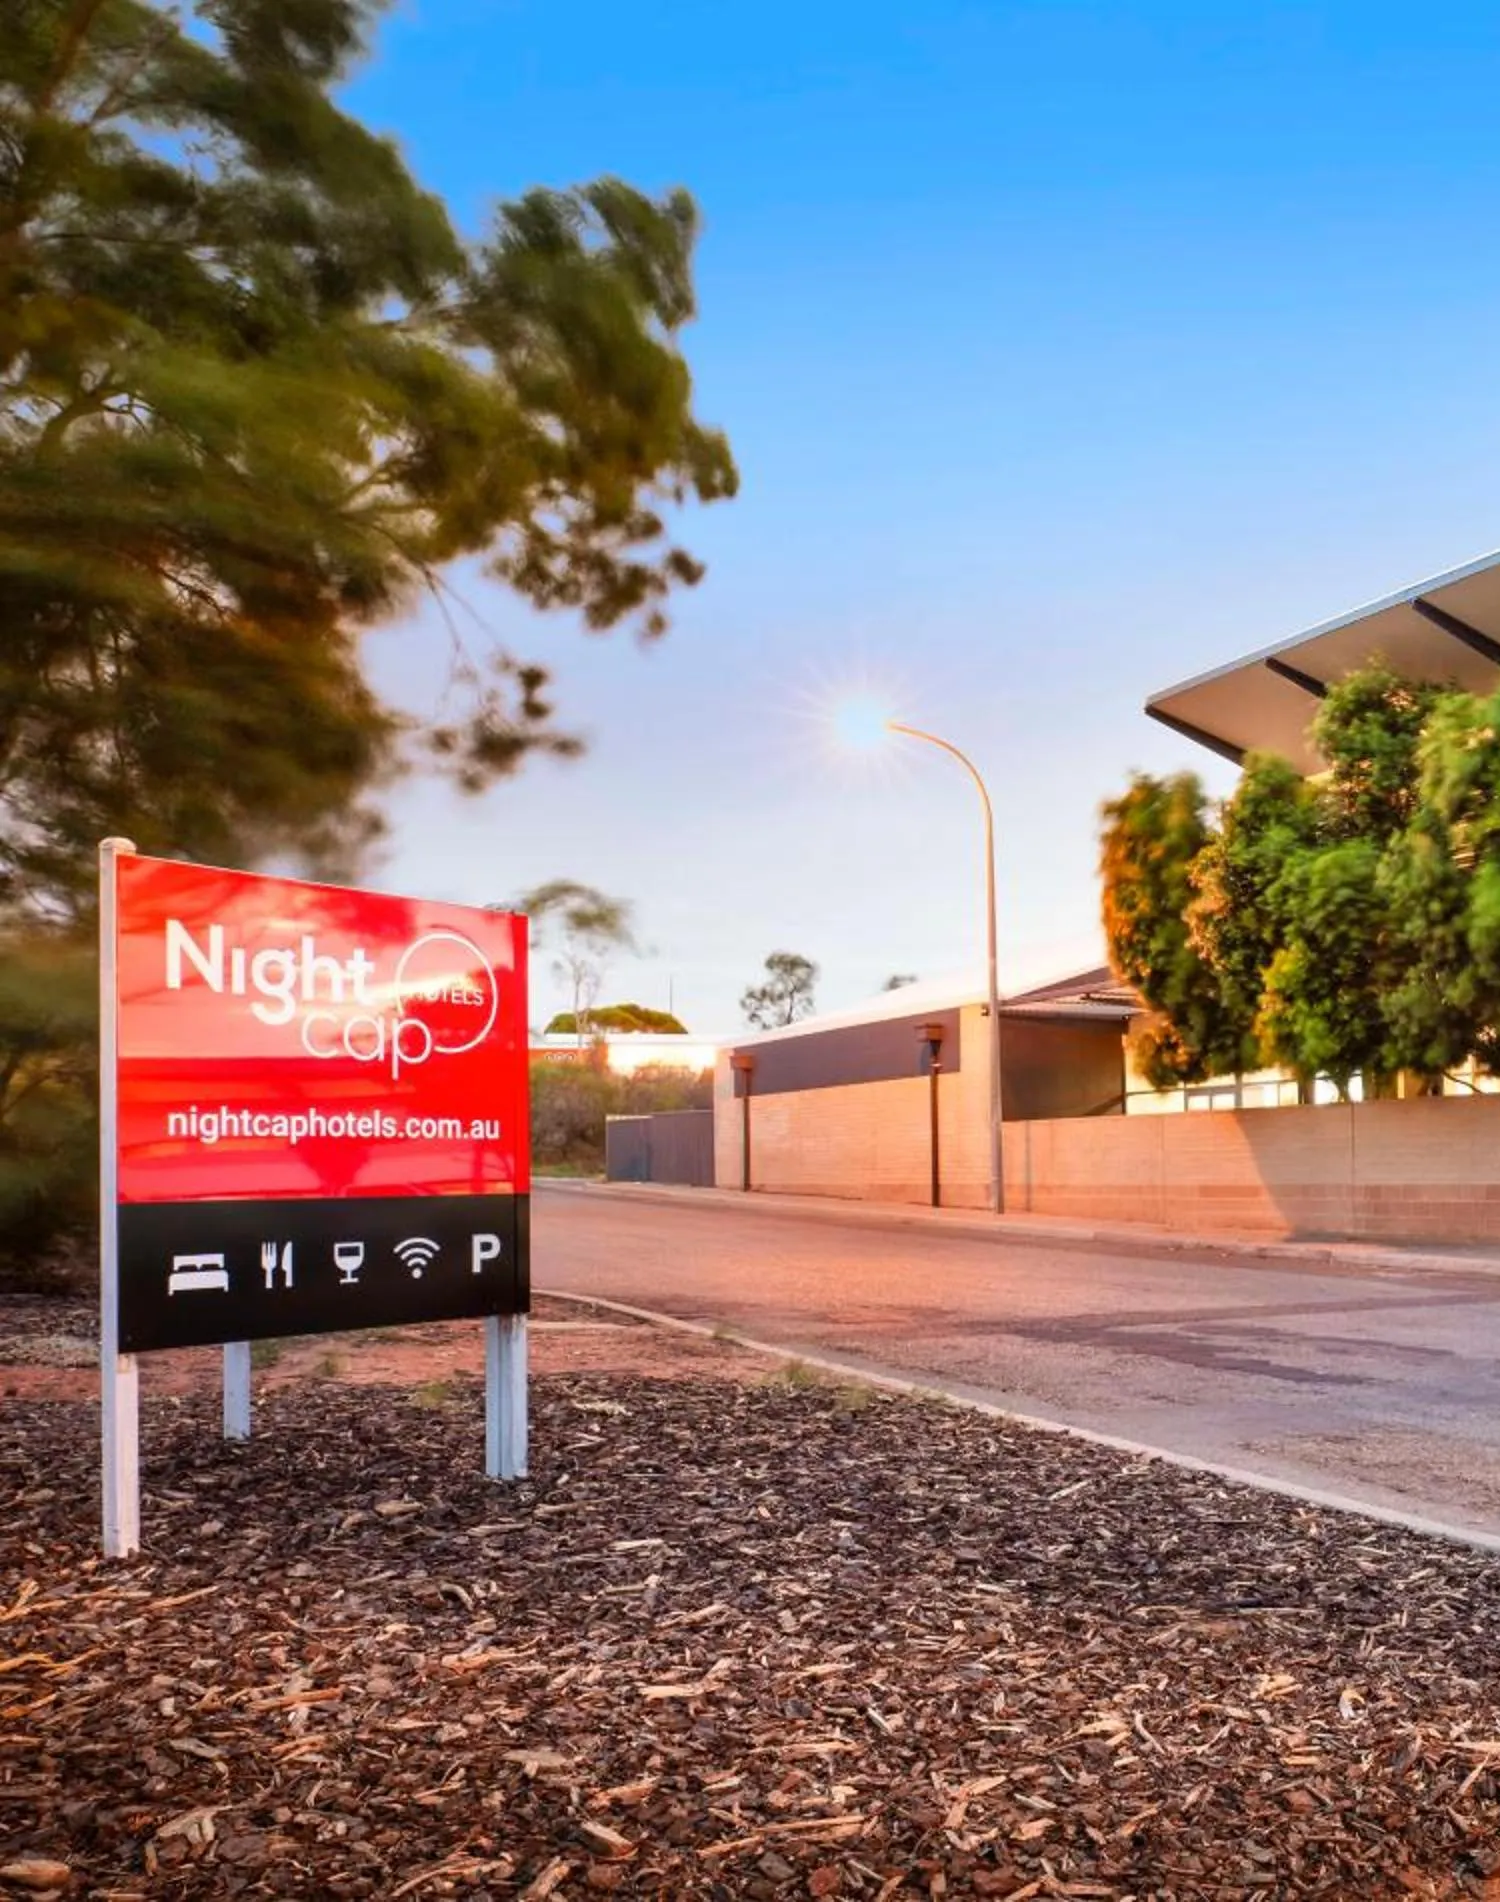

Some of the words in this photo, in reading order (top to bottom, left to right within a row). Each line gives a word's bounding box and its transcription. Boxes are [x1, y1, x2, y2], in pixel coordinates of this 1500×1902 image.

[165, 919, 375, 1026] Night
[302, 1013, 433, 1080] cap
[167, 1106, 500, 1144] nightcaphotels.com.au
[471, 1233, 501, 1273] P
